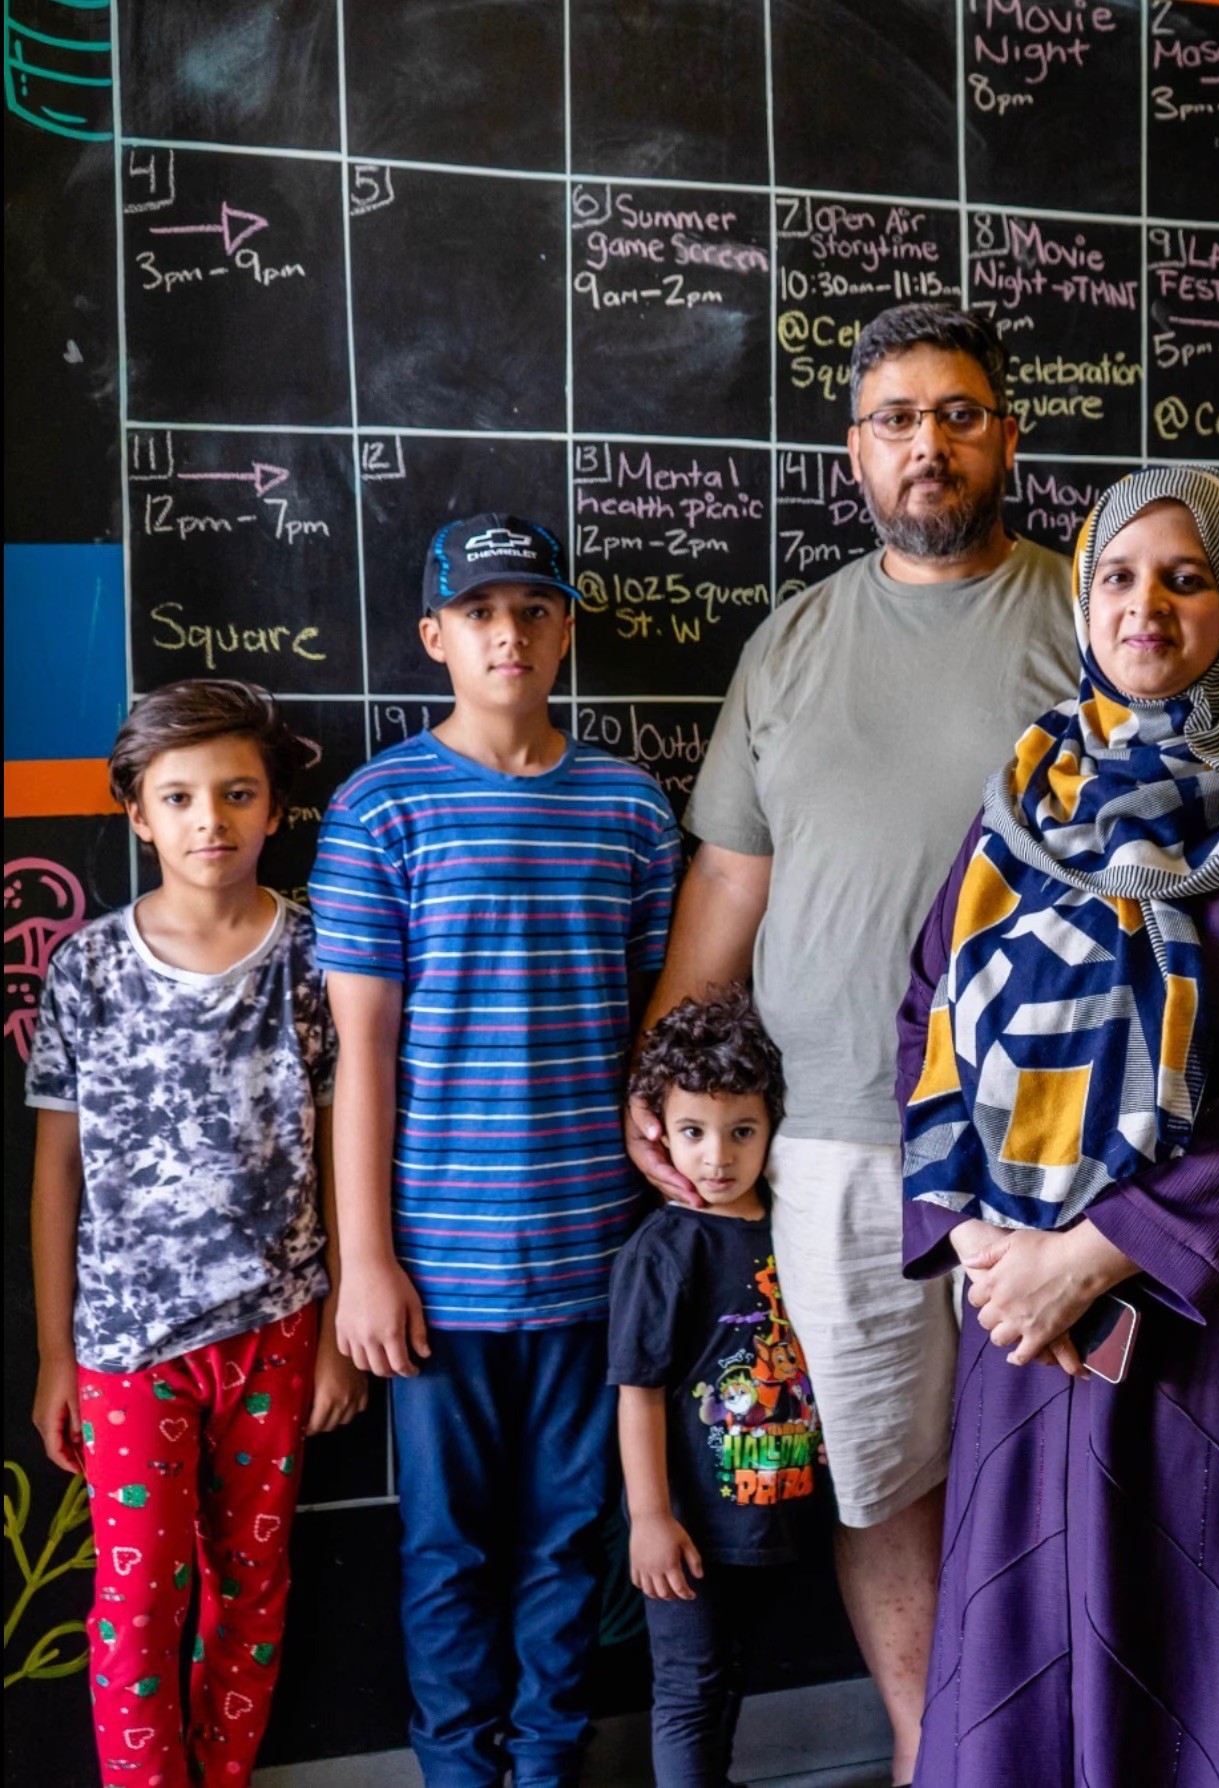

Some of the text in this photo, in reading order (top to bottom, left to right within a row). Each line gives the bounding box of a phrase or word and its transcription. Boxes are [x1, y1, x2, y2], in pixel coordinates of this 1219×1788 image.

[986, 0, 1116, 33] Movie
[1151, 0, 1177, 35] 2
[975, 36, 1090, 84] Night
[968, 74, 1034, 115] 8pm
[128, 153, 155, 193] 4
[353, 165, 379, 203] 5
[572, 184, 600, 217] 6
[615, 193, 737, 232] Summer
[776, 198, 800, 231] 7
[885, 208, 926, 235] Air
[974, 213, 996, 249] 8
[586, 231, 664, 270] game
[810, 233, 939, 272] Storytime
[1009, 219, 1105, 271] Movie
[1151, 229, 1172, 259] 9
[974, 262, 1048, 309] Night
[1006, 389, 1105, 434] quare
[132, 435, 156, 471] 11
[361, 442, 390, 470] 12
[575, 445, 599, 473] 13
[617, 451, 741, 491] Mental
[779, 451, 807, 492] 14
[576, 487, 676, 518] health
[1026, 472, 1101, 506] Movi
[467, 549, 537, 562] CHEVROLET
[694, 579, 771, 624] queen
[150, 601, 327, 670] Square
[670, 613, 701, 644] W
[374, 704, 409, 741] 19
[579, 708, 622, 745] 20
